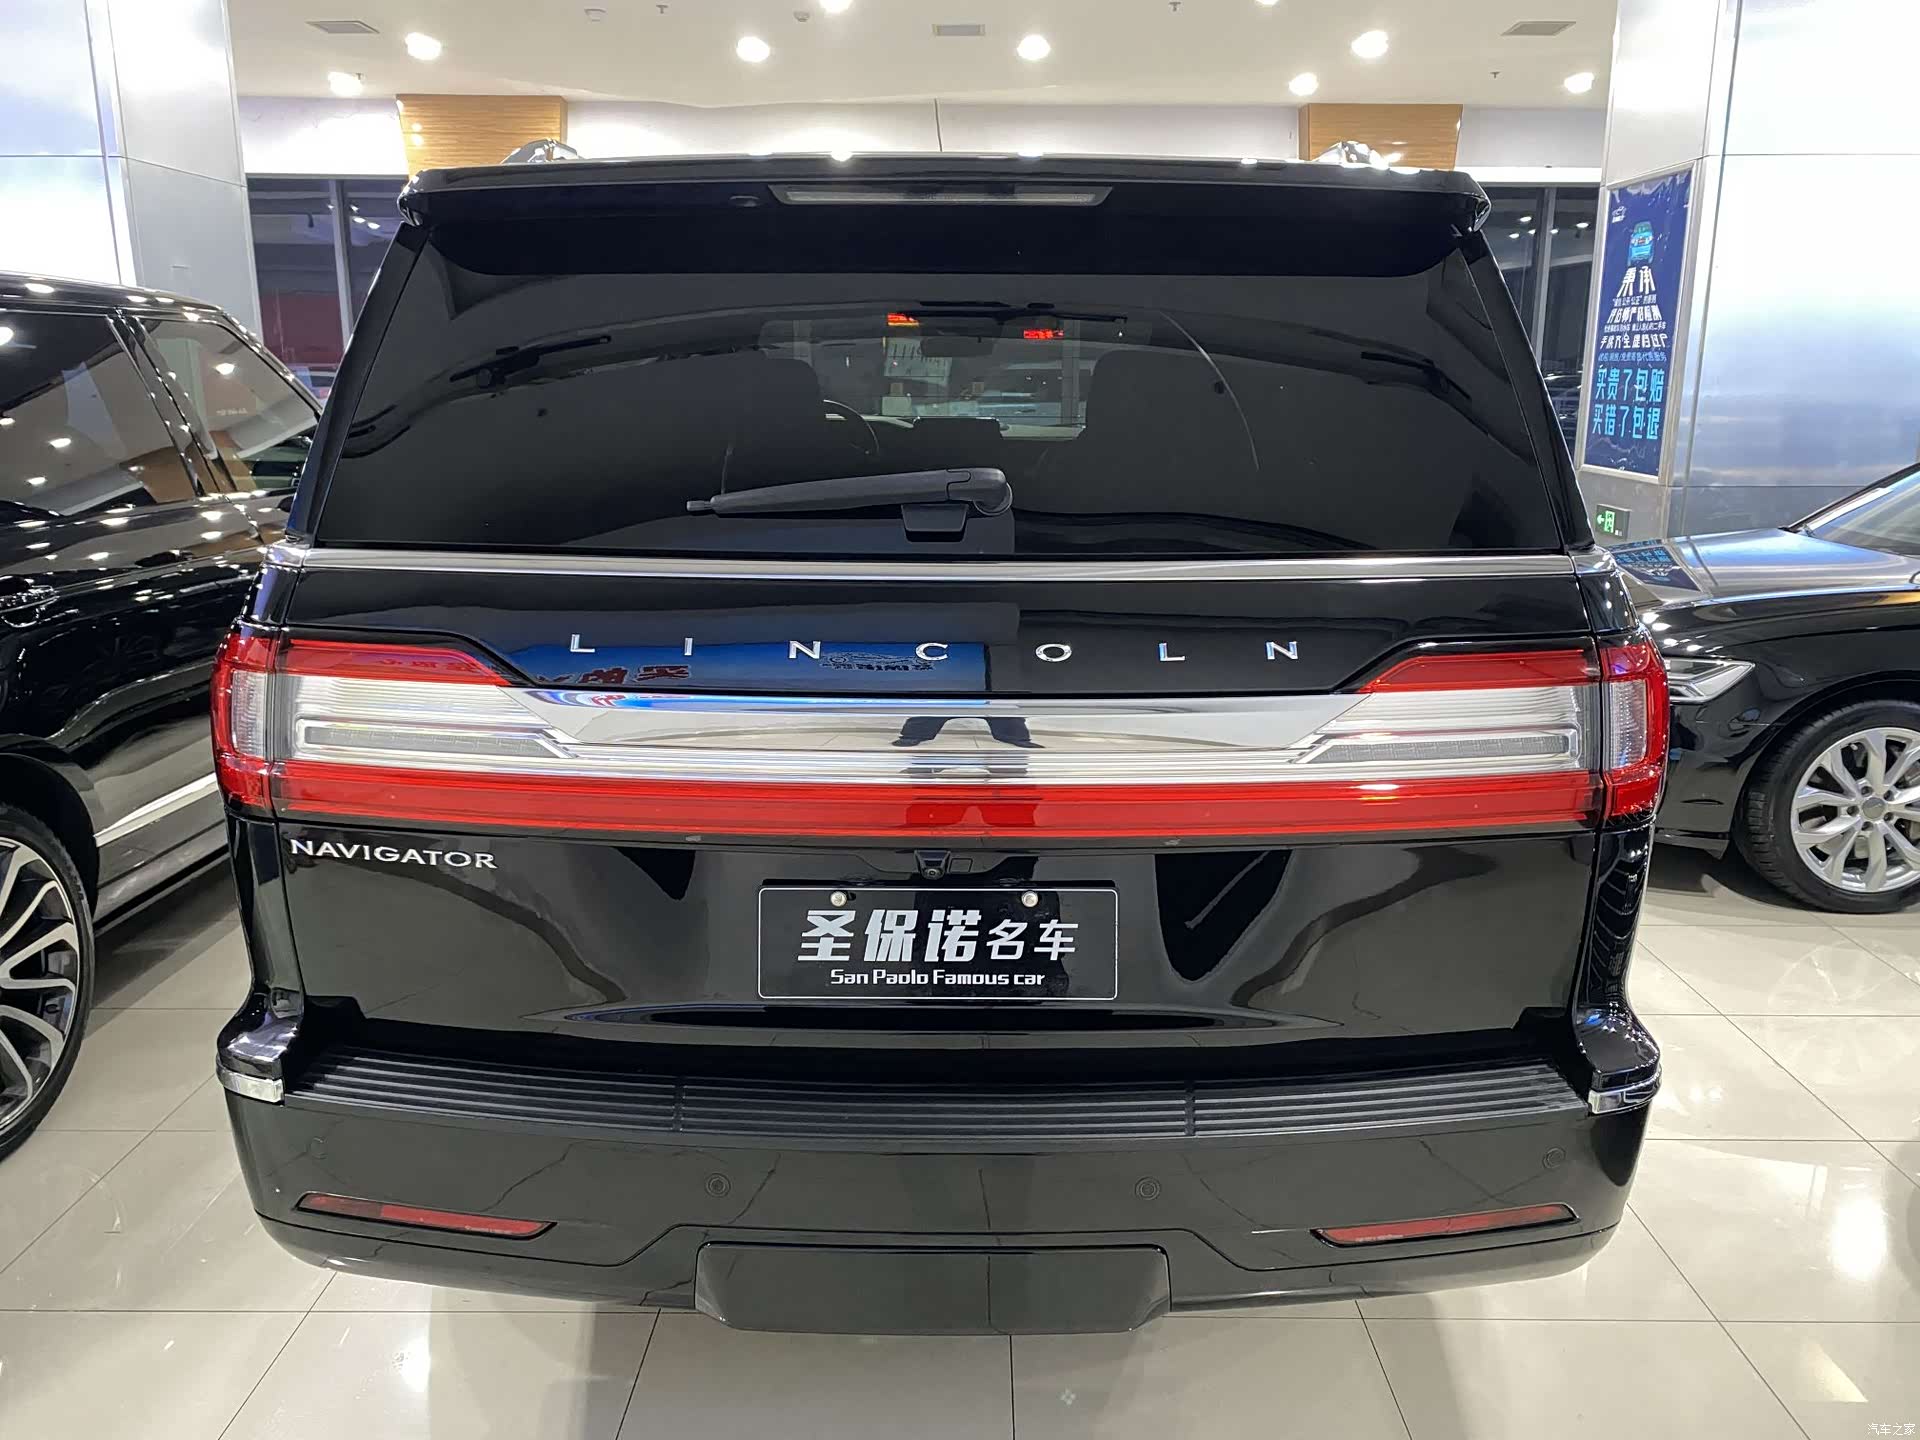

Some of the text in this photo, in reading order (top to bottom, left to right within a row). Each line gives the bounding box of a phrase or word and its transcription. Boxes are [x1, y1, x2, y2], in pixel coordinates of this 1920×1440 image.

[1595, 368, 1665, 403] 买贵了包赔
[1592, 404, 1661, 440] 买错了包退
[570, 633, 1298, 664] LINCOLN
[290, 838, 498, 869] NAVIGATOR
[797, 909, 1079, 962] 圣保诺名车
[830, 969, 1046, 985] San Paolo Famous car
